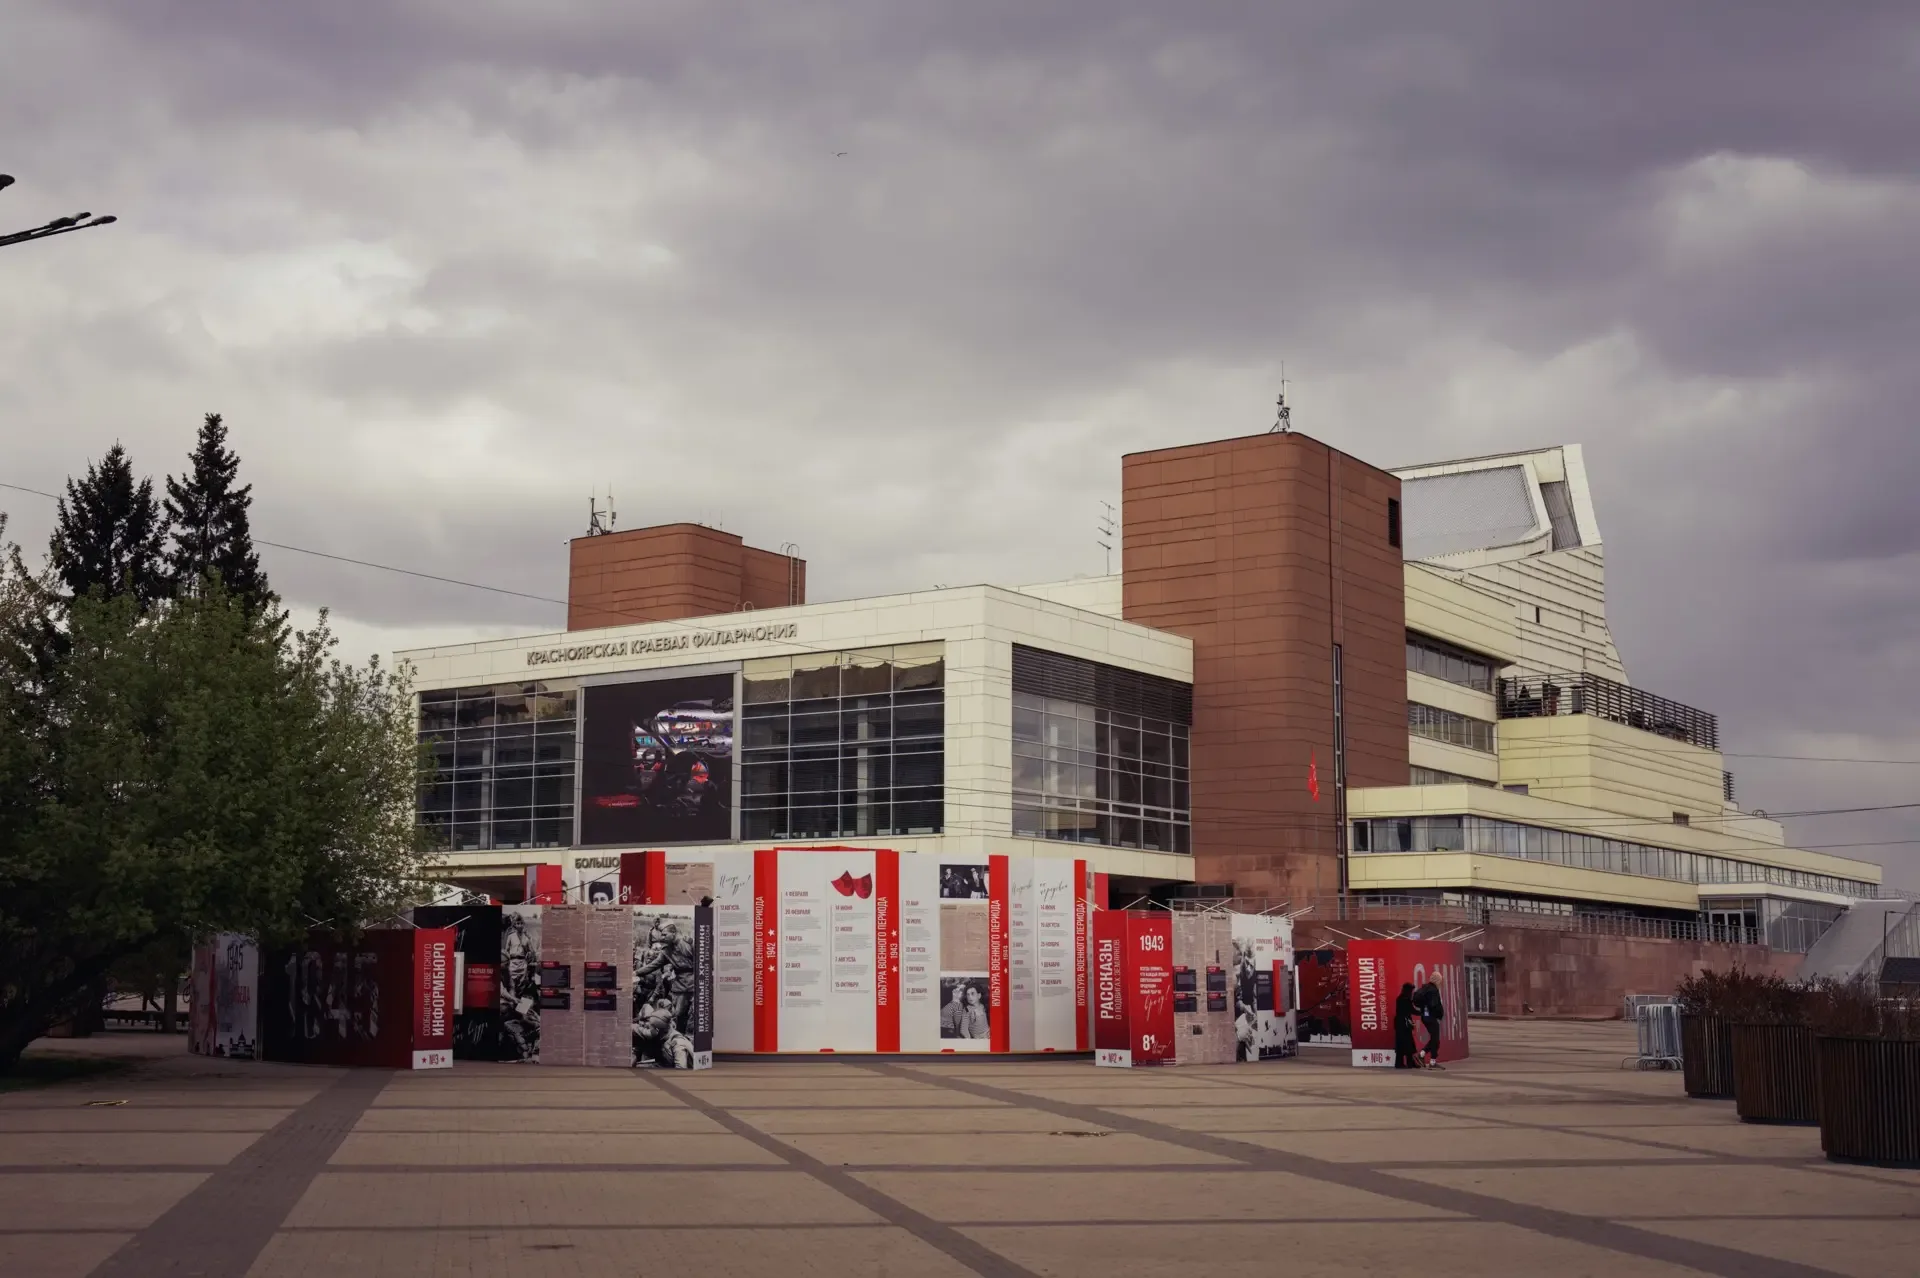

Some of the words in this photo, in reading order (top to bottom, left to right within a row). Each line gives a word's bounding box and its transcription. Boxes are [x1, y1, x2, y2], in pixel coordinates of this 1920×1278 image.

[526, 641, 628, 666] КРАСНОЯРСКАЯ
[630, 635, 689, 656] КРАЕВАЯ
[692, 622, 798, 649] ФИЛАРМОНИЯ
[574, 856, 620, 869] БОЛЬШО
[756, 896, 764, 929] ПЕРИОДА
[878, 896, 887, 930] ПЕРИОДА
[991, 900, 1000, 932] ПЕРИОДА
[1076, 903, 1085, 934] ПЕРИОДА
[227, 944, 243, 971] 1945
[756, 932, 764, 968] ВОЕННОГО
[766, 942, 775, 958] 1942
[878, 932, 887, 969] ВОЕННОГО
[991, 934, 1000, 971] ВОЕННОГО
[1076, 936, 1085, 971] ВОЕННОГО
[1140, 935, 1164, 951] 1943
[423, 943, 431, 990] СОВЕТСКОГО
[1099, 940, 1114, 1019] РАССКАЗЫ
[432, 942, 445, 1036] ИНФОРМБЮРО
[756, 970, 764, 1006] КУЛЬТУРА
[878, 970, 887, 1006] КУЛЬТУРА
[991, 972, 1000, 1007] КУЛЬТУРА
[1076, 973, 1085, 1006] КУЛЬТУРА
[1114, 977, 1122, 1013] ПОДВИГАХ
[1358, 958, 1377, 1030] ЭВАКУАЦИЯ
[423, 992, 431, 1036] СООБЩЕНИЕ
[1371, 1052, 1383, 1063] №6
